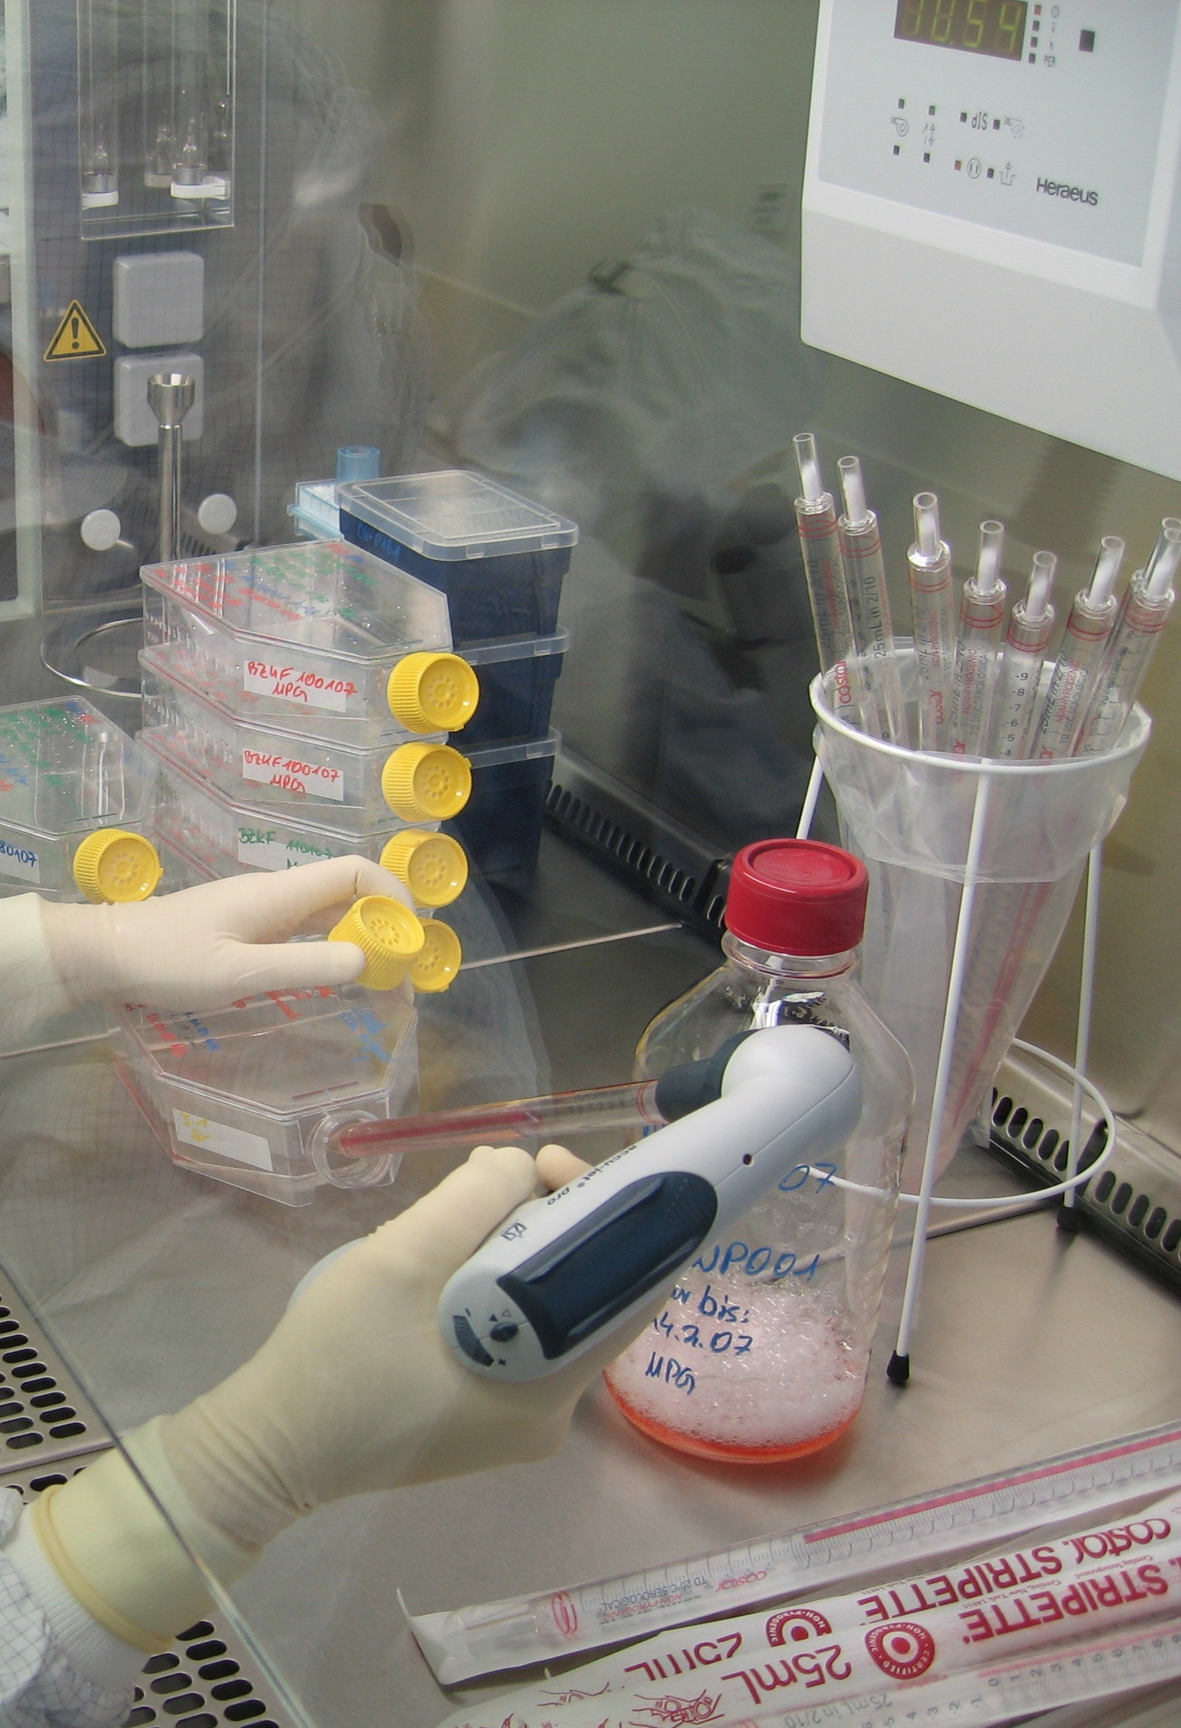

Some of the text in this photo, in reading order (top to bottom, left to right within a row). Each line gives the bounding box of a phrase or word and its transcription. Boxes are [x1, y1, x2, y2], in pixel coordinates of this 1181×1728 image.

[1036, 177, 1099, 206] Heraeus
[863, 575, 879, 604] 2/10
[867, 605, 881, 619] in
[869, 620, 887, 660] 25mL
[547, 1187, 571, 1206] pro
[714, 1569, 768, 1593] costar
[599, 1585, 669, 1612] SEROLOGICAL
[720, 1644, 852, 1705] 25mL
[881, 1649, 931, 1677] CERTIFIED
